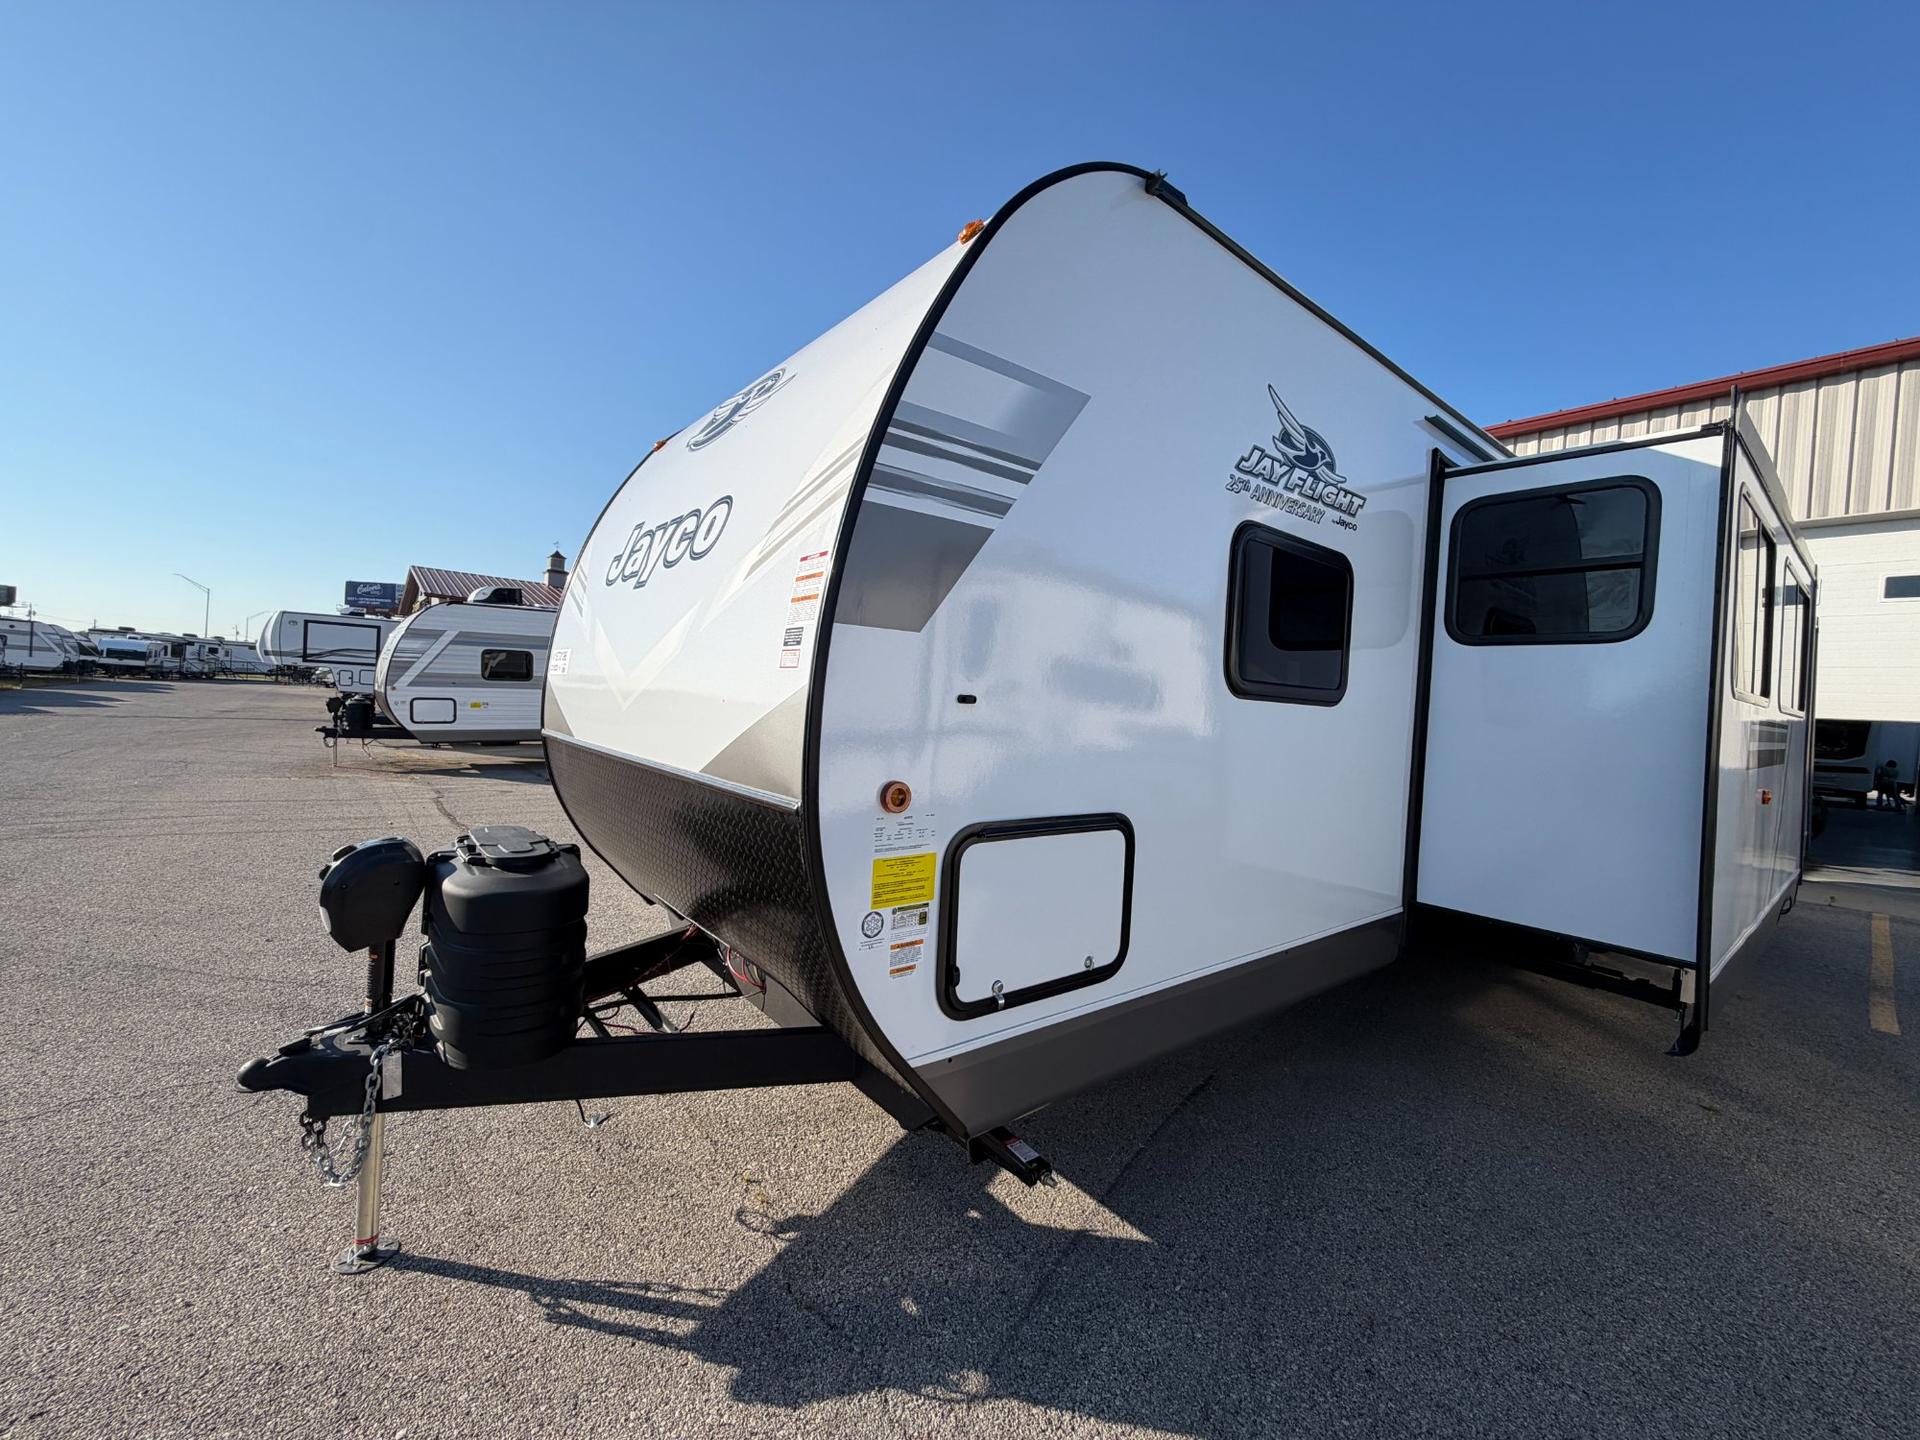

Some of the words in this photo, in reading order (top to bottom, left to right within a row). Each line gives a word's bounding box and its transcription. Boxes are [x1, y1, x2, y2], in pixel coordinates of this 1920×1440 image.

[1225, 474, 1251, 495] 25th
[1250, 484, 1325, 524] ANNIVERSARY
[1235, 445, 1290, 485] JAY
[1283, 467, 1367, 517] FLIGHT
[1336, 515, 1358, 532] Jayco
